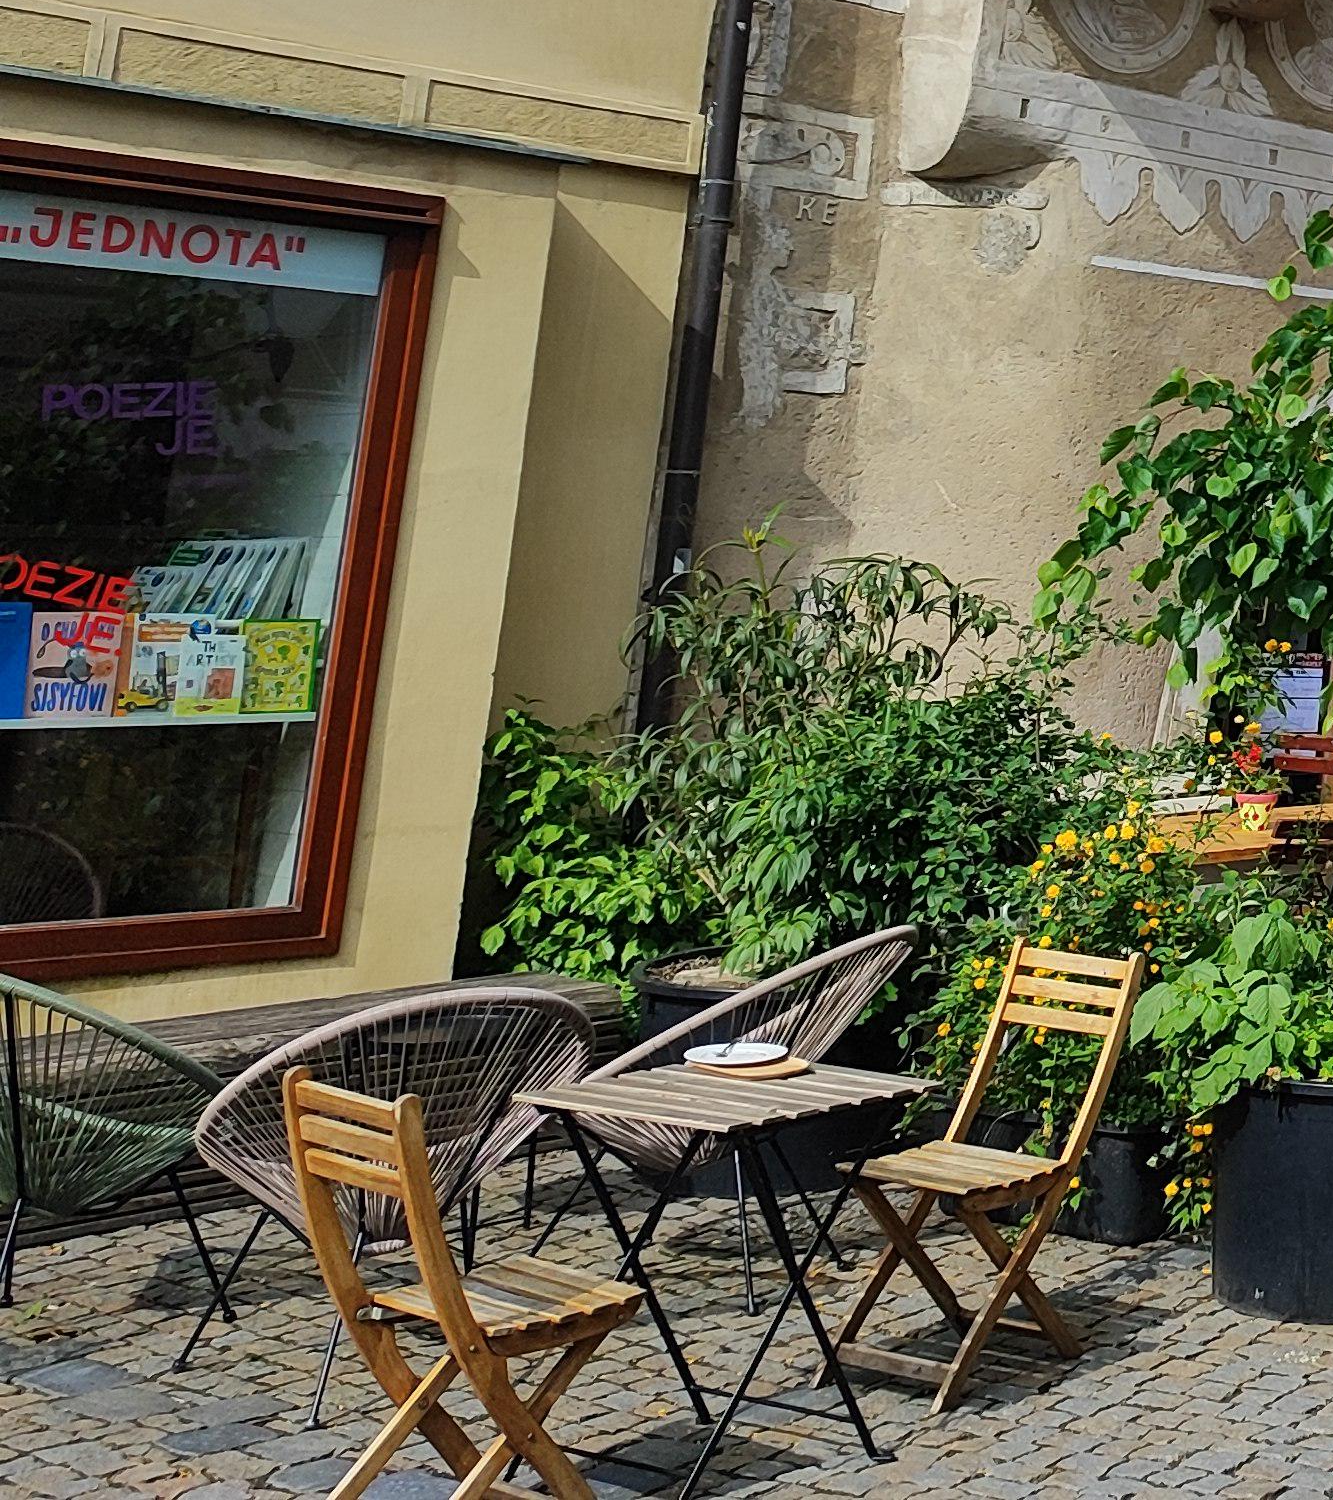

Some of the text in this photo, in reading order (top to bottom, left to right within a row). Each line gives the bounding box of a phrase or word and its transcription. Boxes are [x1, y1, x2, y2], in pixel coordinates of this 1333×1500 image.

[41, 380, 217, 421] POEZIE
[155, 417, 218, 456] JE
[31, 682, 108, 713] SISYFOVI
